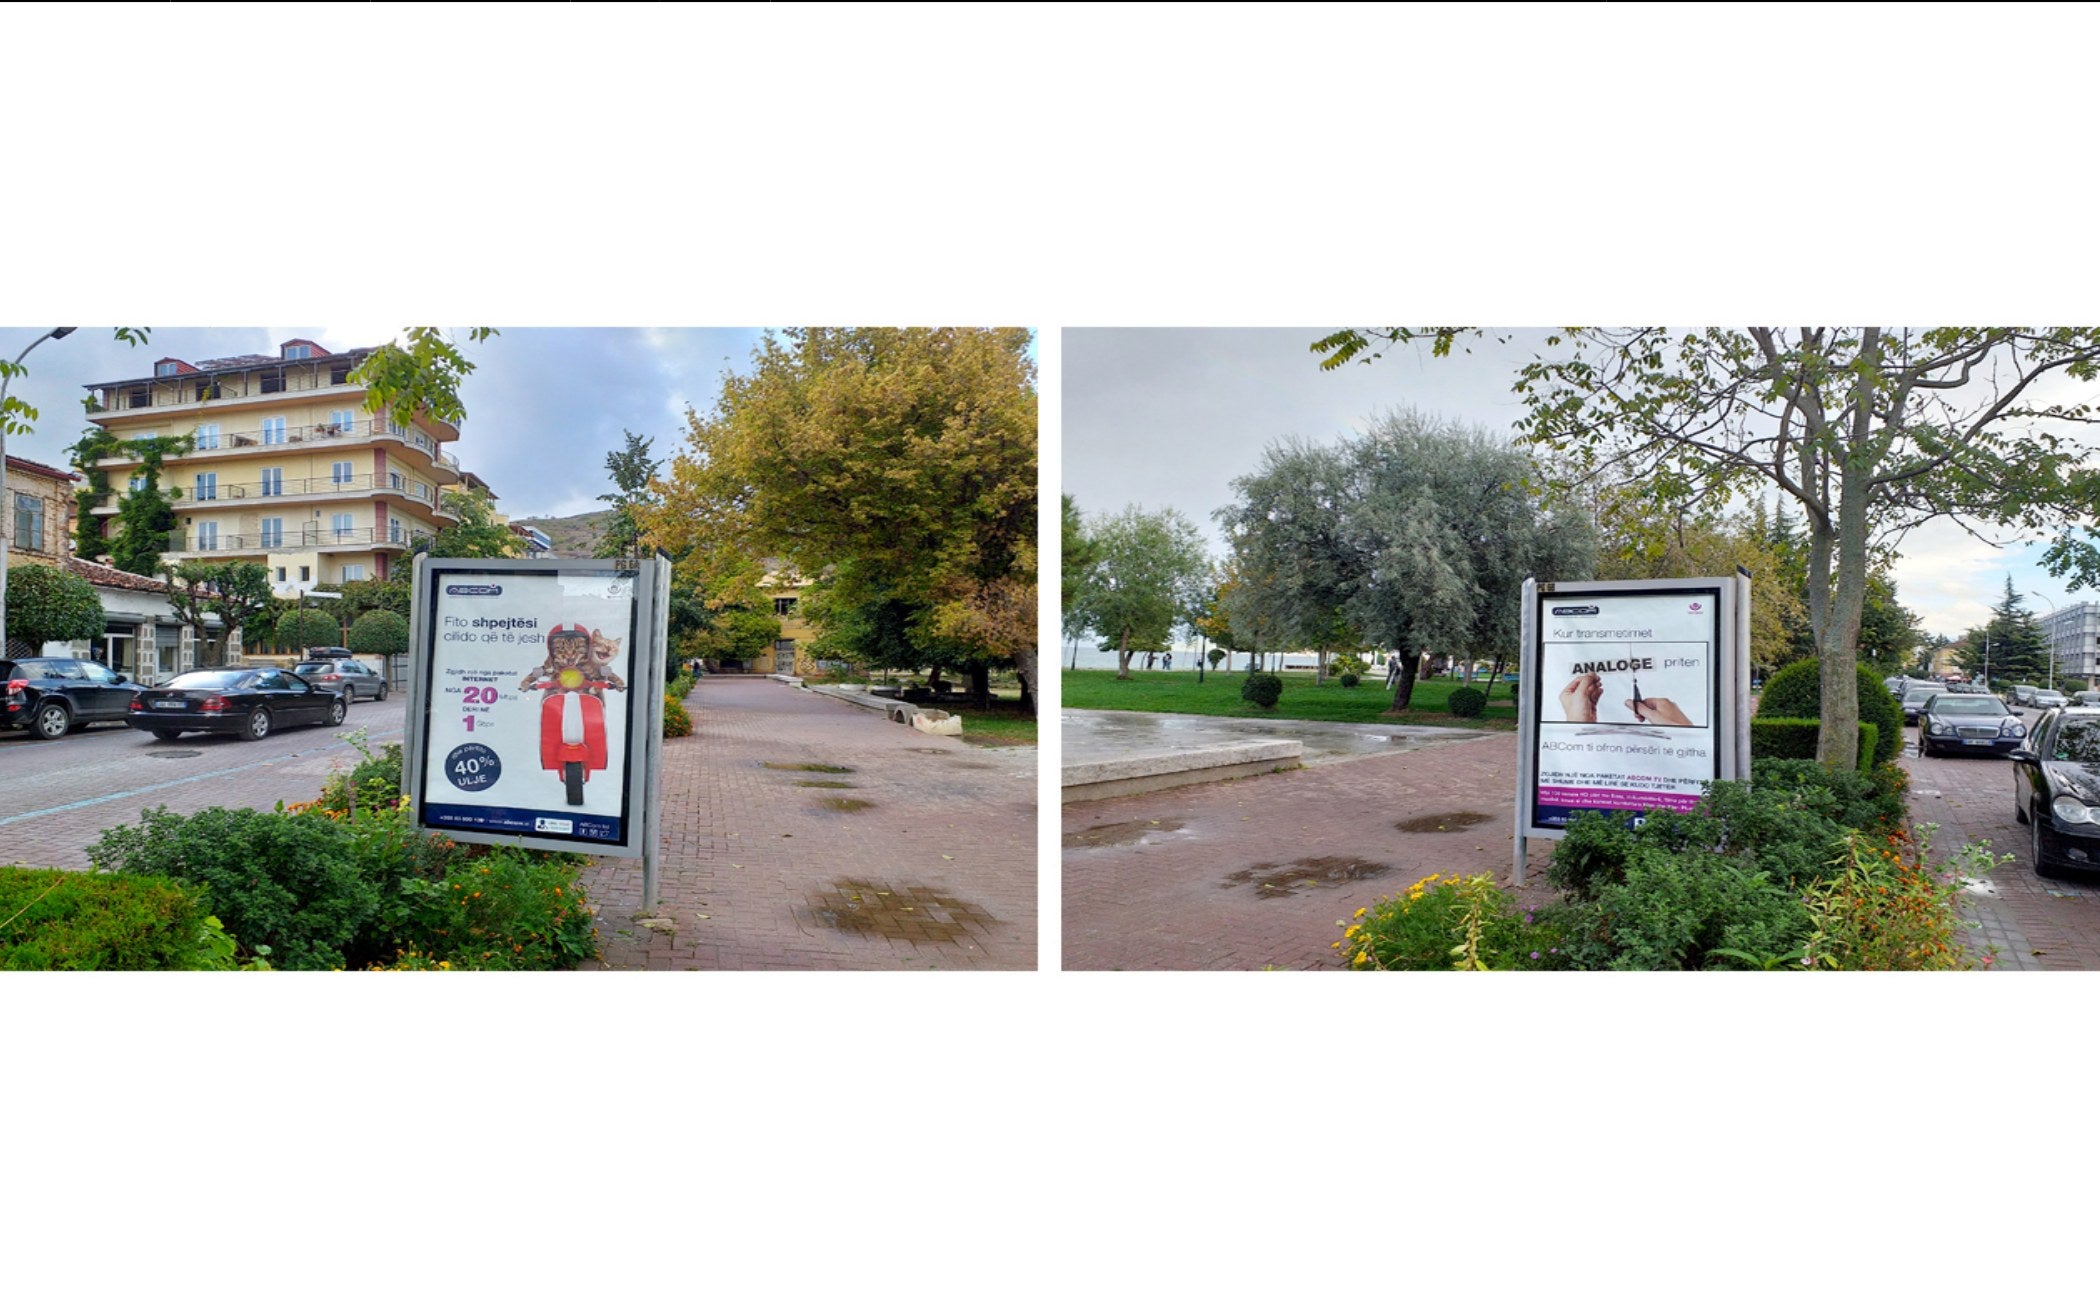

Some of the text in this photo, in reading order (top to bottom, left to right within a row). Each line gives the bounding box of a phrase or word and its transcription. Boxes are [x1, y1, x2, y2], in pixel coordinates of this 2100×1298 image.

[444, 616, 538, 630] Fito shpejtësi
[444, 631, 545, 645] cilido që të jesh
[1553, 628, 1653, 638] Kur transmetimet
[1572, 656, 1700, 675] ANALOGE priten
[463, 715, 474, 732] 1
[1542, 741, 1584, 752] ABCom
[1596, 743, 1622, 753] ofron
[455, 755, 495, 775] 40%
[457, 774, 487, 786] ULJE
